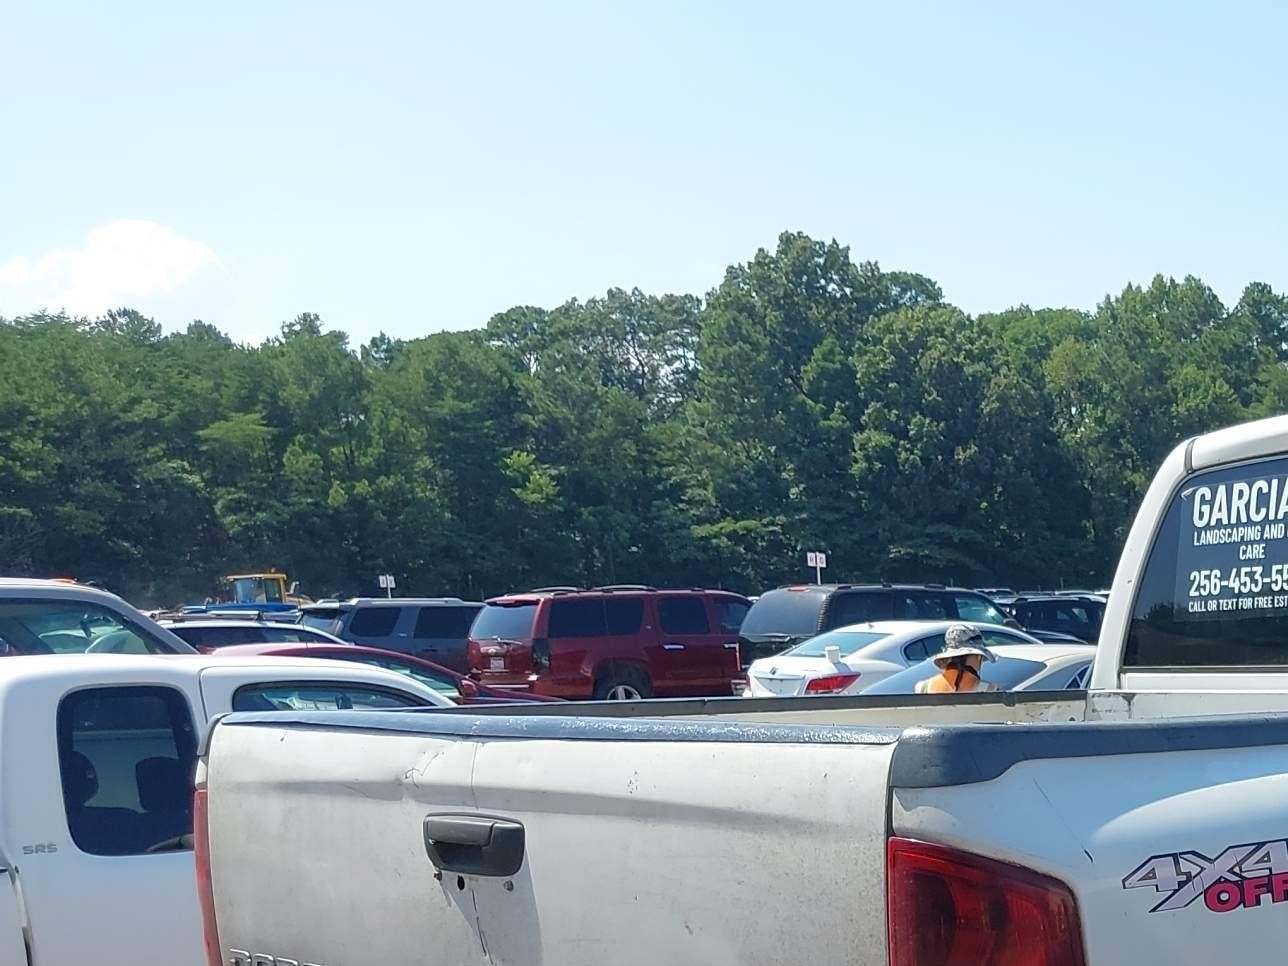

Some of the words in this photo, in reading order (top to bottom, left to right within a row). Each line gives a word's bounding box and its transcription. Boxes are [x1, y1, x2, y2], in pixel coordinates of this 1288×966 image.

[1194, 525, 1261, 546] LANDSCAPING
[1263, 523, 1284, 539] AND
[1239, 544, 1266, 560] CARE
[1188, 600, 1206, 613] CALL
[1207, 600, 1218, 612] OR
[1219, 599, 1237, 611] TEXT
[1238, 598, 1253, 610] FOR
[1254, 597, 1273, 608] FREE
